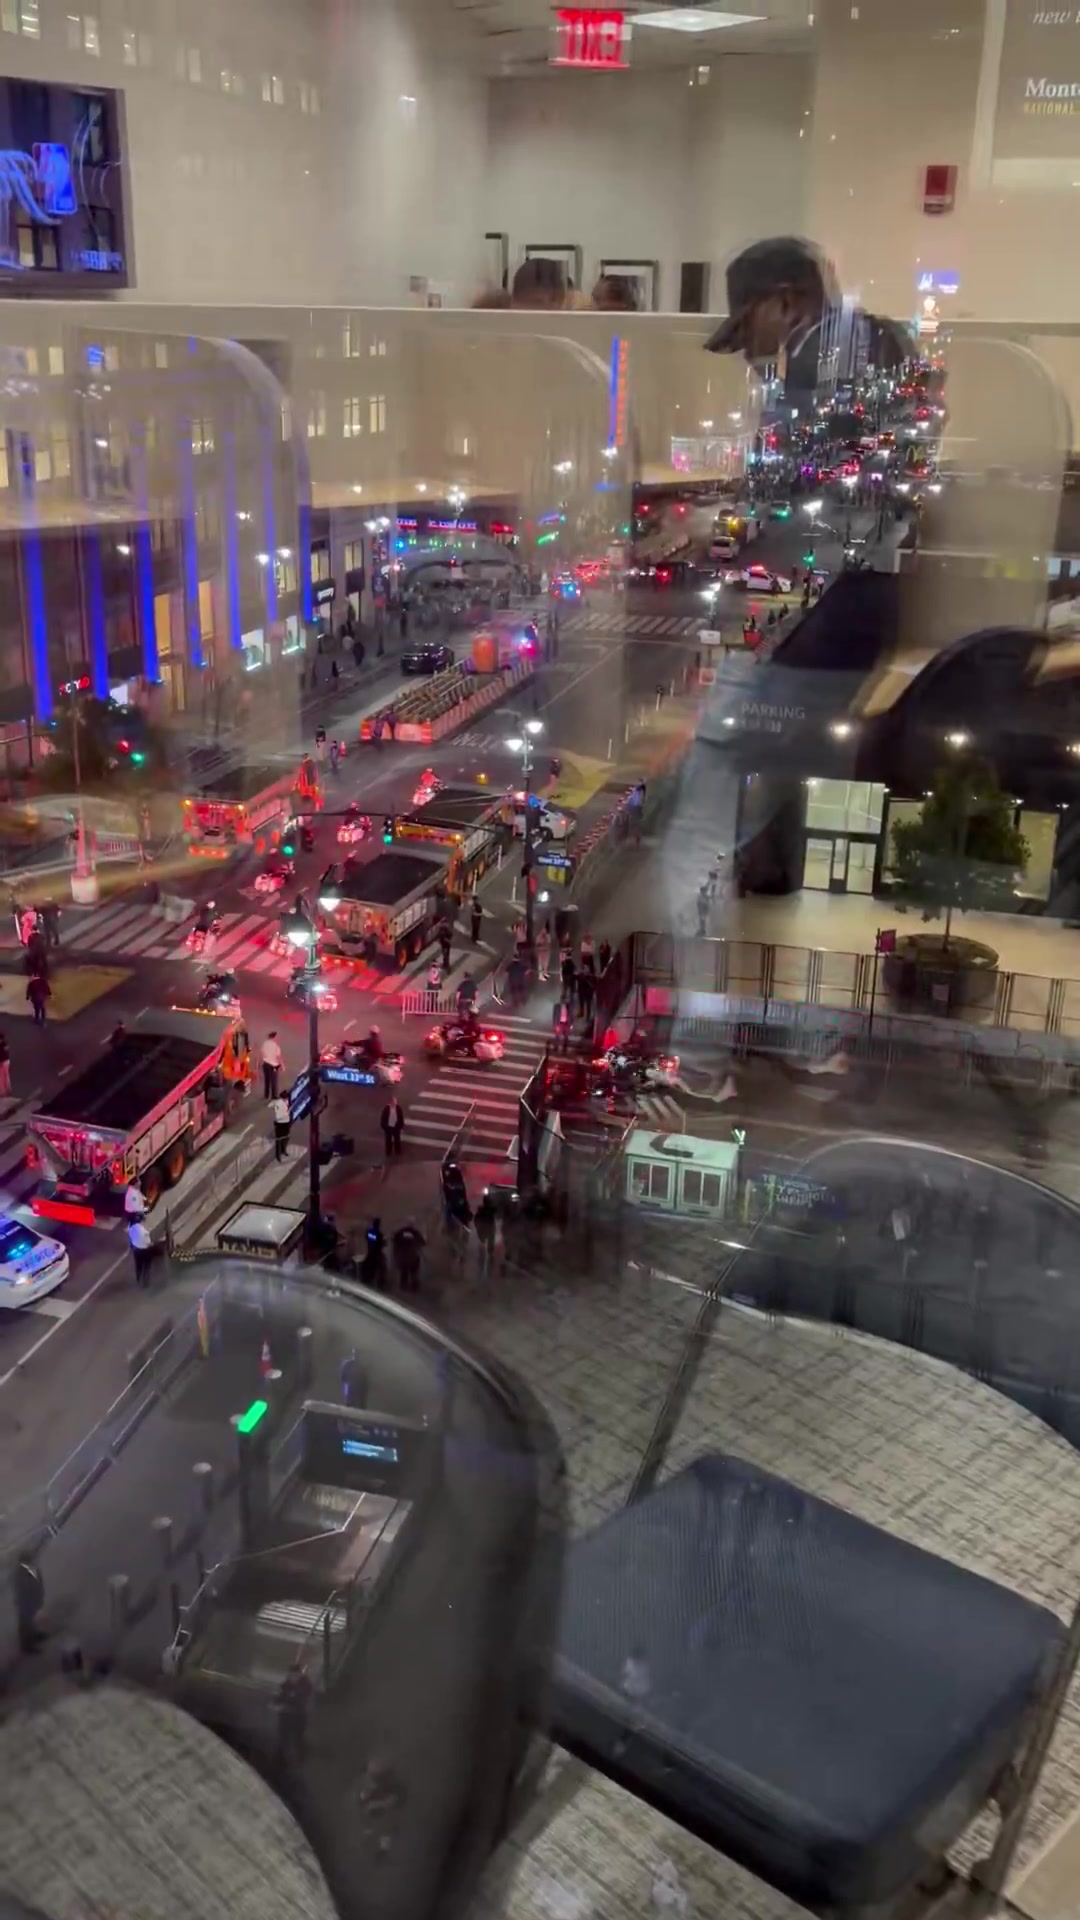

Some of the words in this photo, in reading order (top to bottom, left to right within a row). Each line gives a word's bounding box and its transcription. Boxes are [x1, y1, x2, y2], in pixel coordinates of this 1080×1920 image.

[1033, 11, 1071, 24] new
[1025, 78, 1080, 97] Mont
[742, 701, 806, 719] PARKING
